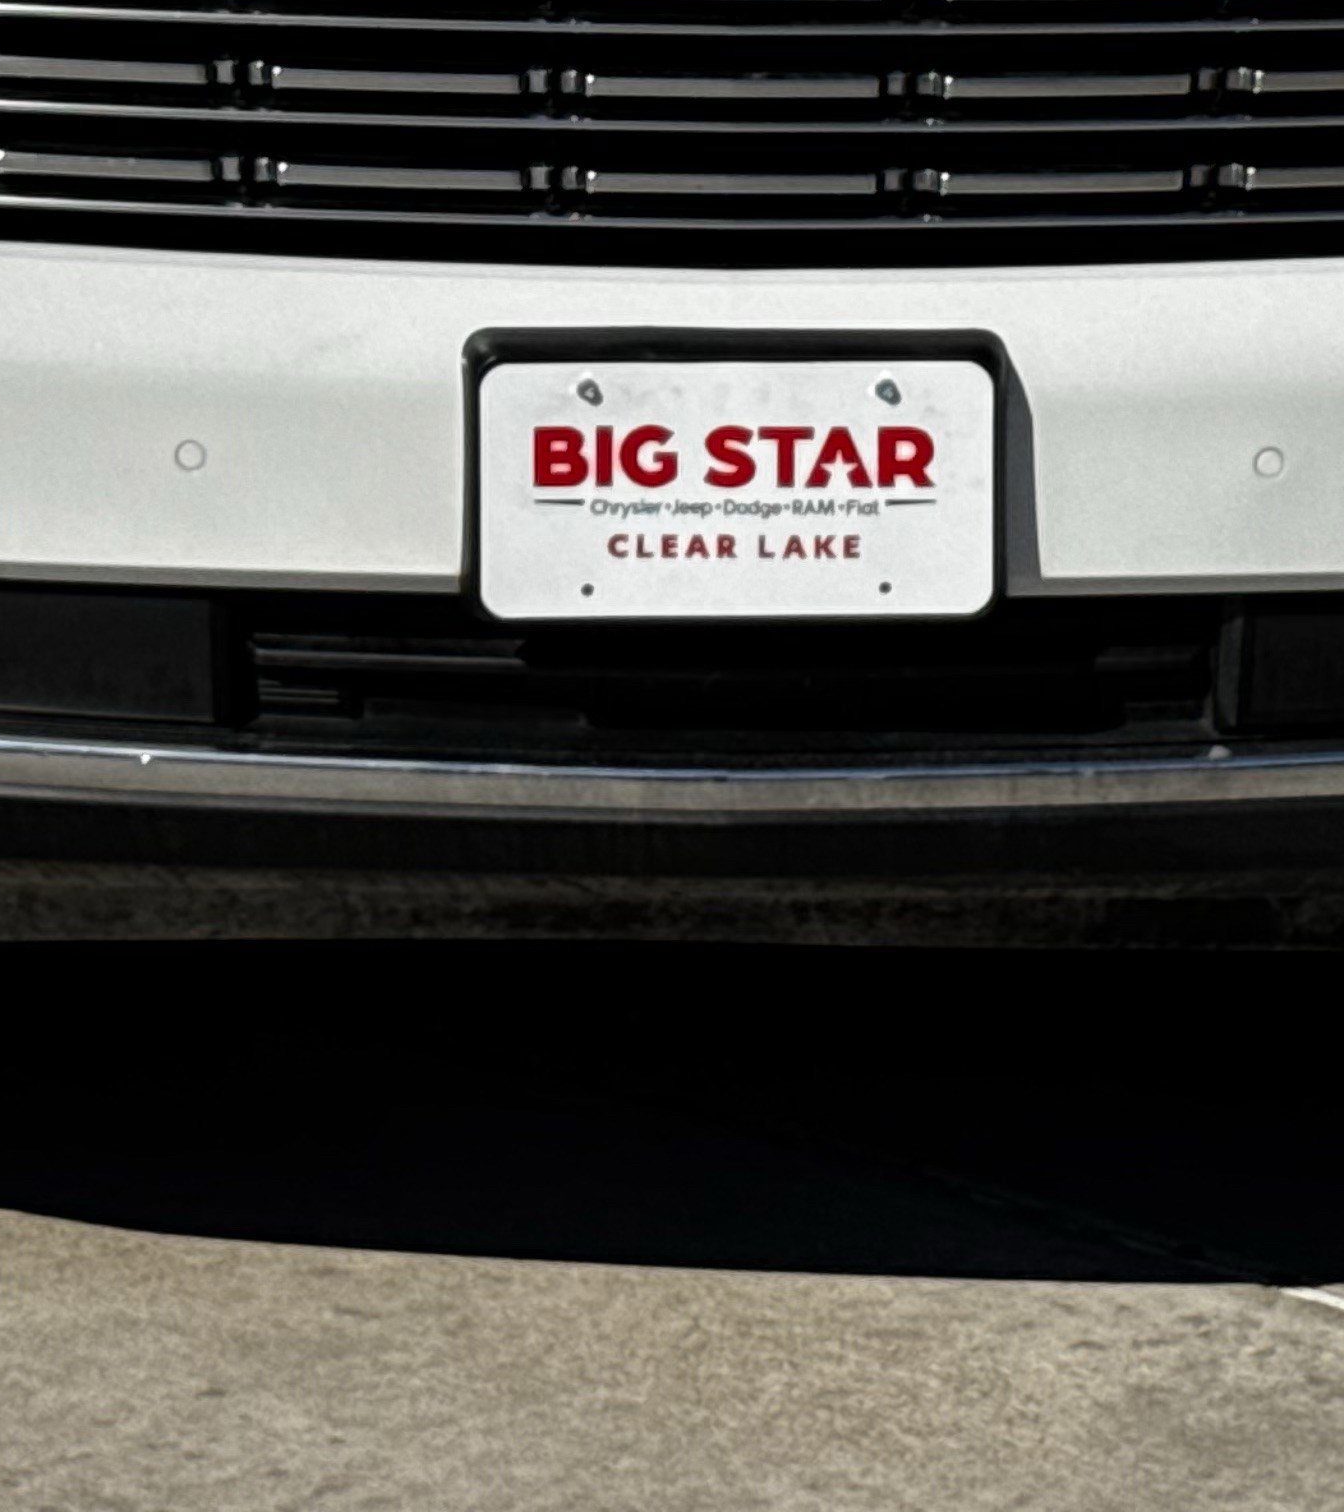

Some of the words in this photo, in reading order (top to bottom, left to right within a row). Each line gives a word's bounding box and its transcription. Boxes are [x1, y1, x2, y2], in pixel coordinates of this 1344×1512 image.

[532, 424, 679, 489] BIG
[703, 425, 936, 489] STAR
[606, 533, 738, 560] CLEAR
[757, 533, 861, 560] LAKE
